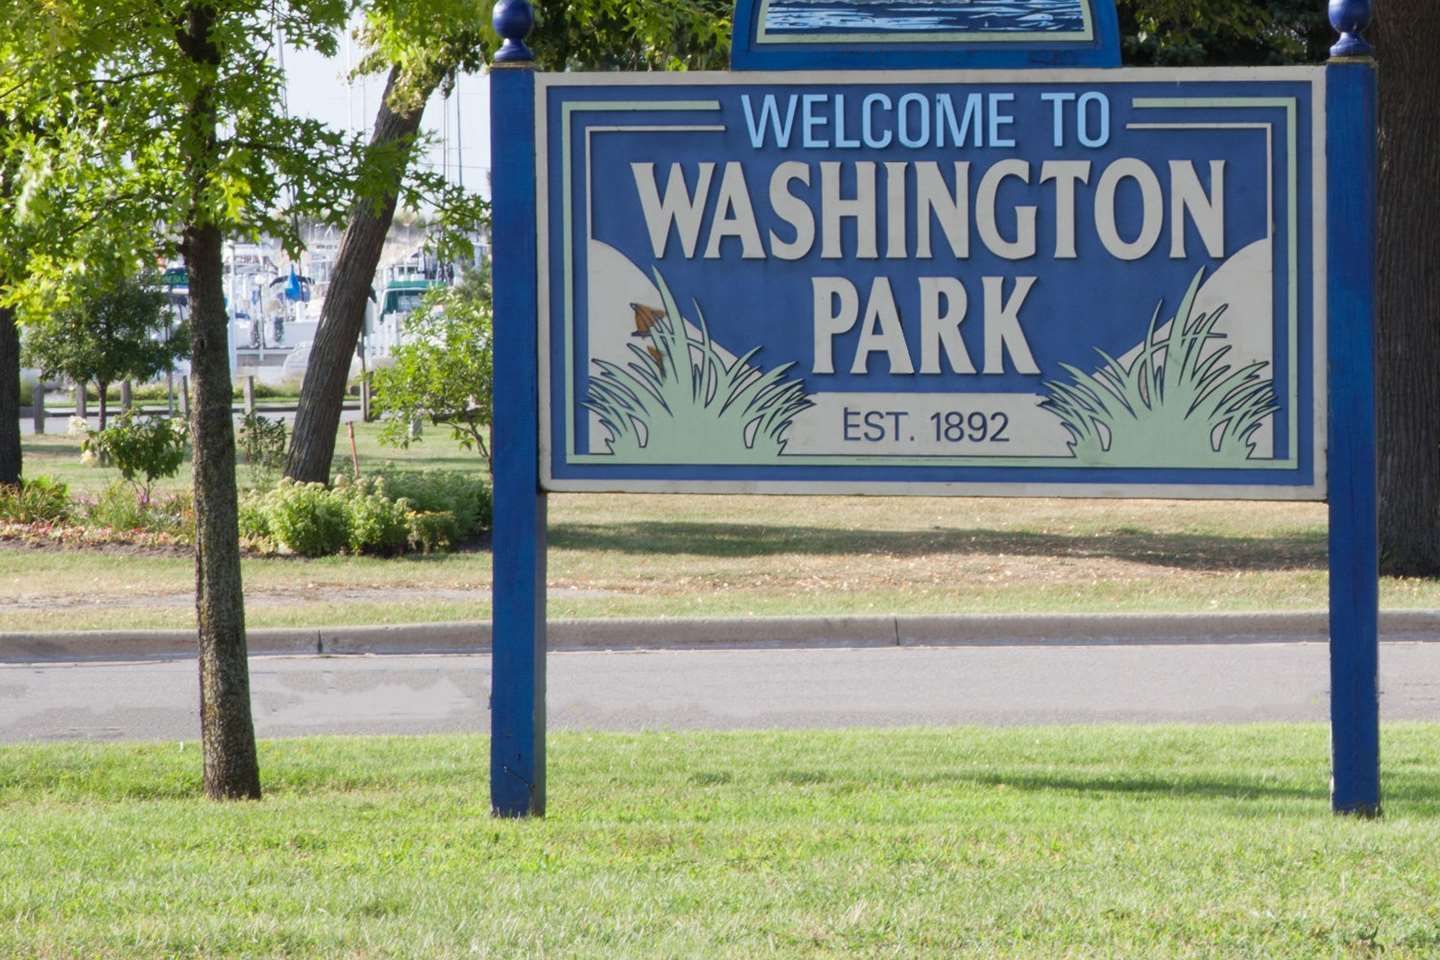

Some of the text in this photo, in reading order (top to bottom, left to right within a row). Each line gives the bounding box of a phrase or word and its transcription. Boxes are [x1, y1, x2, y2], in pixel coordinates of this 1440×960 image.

[741, 91, 1110, 148] WELCOME TO
[630, 157, 1225, 259] WASHINGTON
[811, 276, 1041, 374] PARK
[843, 407, 1010, 442] EST. 1892
